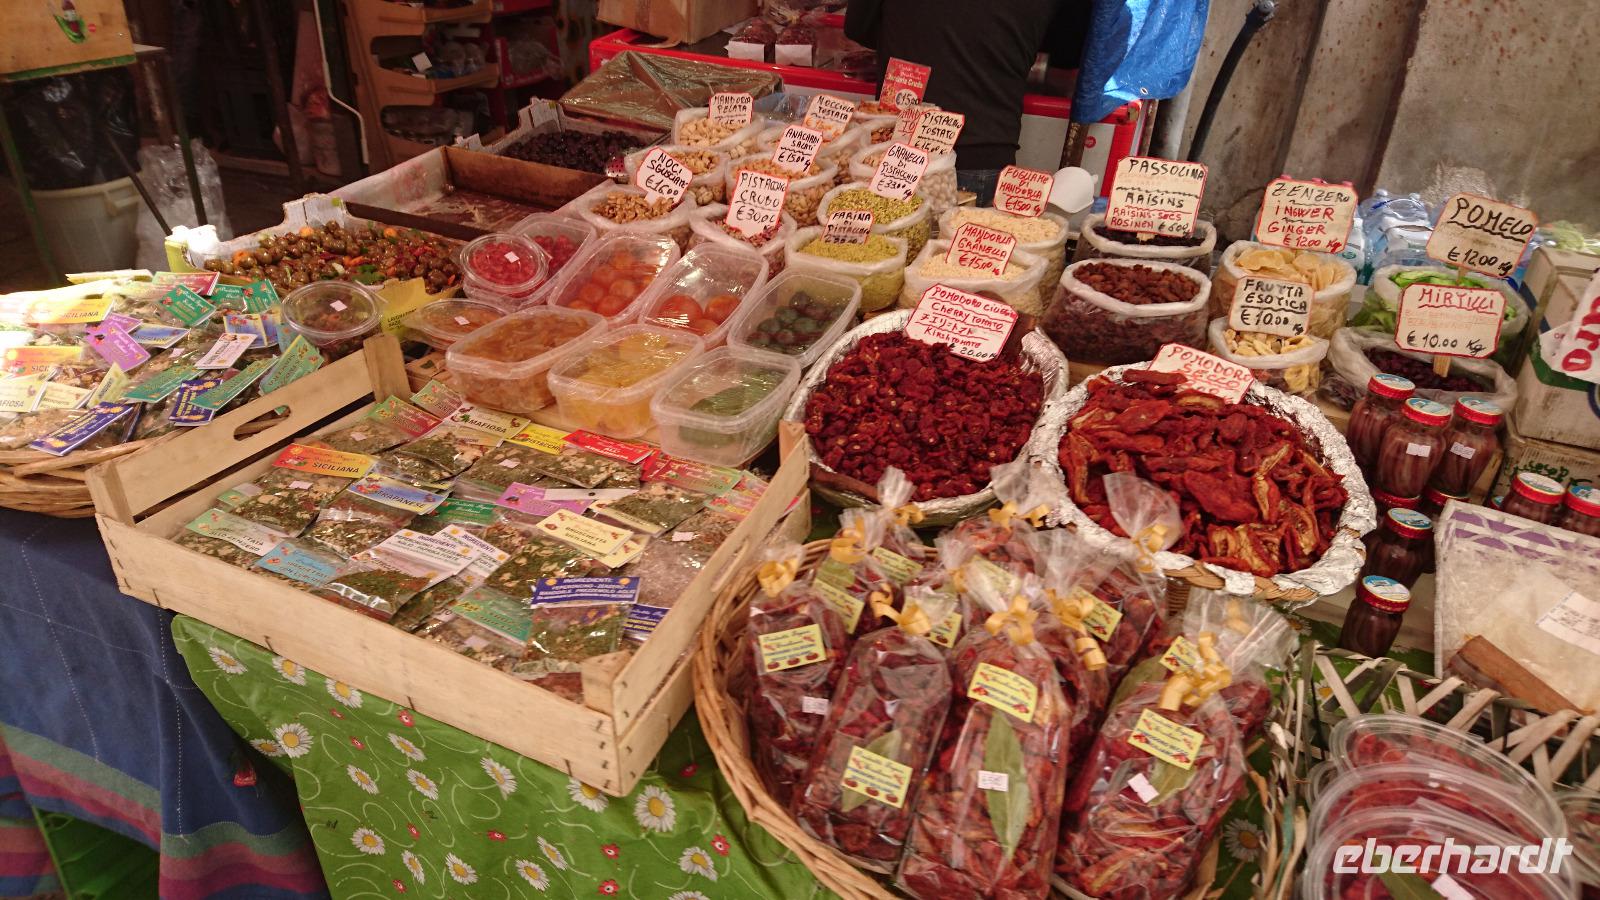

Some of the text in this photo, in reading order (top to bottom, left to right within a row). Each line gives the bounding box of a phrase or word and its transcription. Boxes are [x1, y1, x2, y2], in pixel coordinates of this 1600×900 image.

[717, 105, 747, 114] PELATA
[818, 106, 849, 121] TOSTATA
[921, 125, 955, 139] TOSTATO
[657, 152, 682, 174] NOCI
[881, 162, 918, 182] PISTACCHIO
[1129, 159, 1205, 180] PASSOLINA
[740, 189, 780, 207] CRUDO
[1272, 182, 1350, 203] ZENZERO
[832, 211, 871, 221] FARINA
[1450, 197, 1533, 235] POMELO
[962, 225, 1012, 245] MANDORLA
[1267, 221, 1327, 235] GINGER
[957, 237, 1007, 258] GRANELLA
[931, 286, 982, 308] POMODORO
[1243, 279, 1304, 298] FRUTTA
[1418, 288, 1494, 309] MIRTILLI
[1245, 292, 1307, 312] ESOTICA
[1168, 346, 1253, 383] POMODORO
[1183, 363, 1240, 389] SECCO
[469, 418, 507, 434] MAFIOSA
[312, 462, 360, 473] SICILIANA
